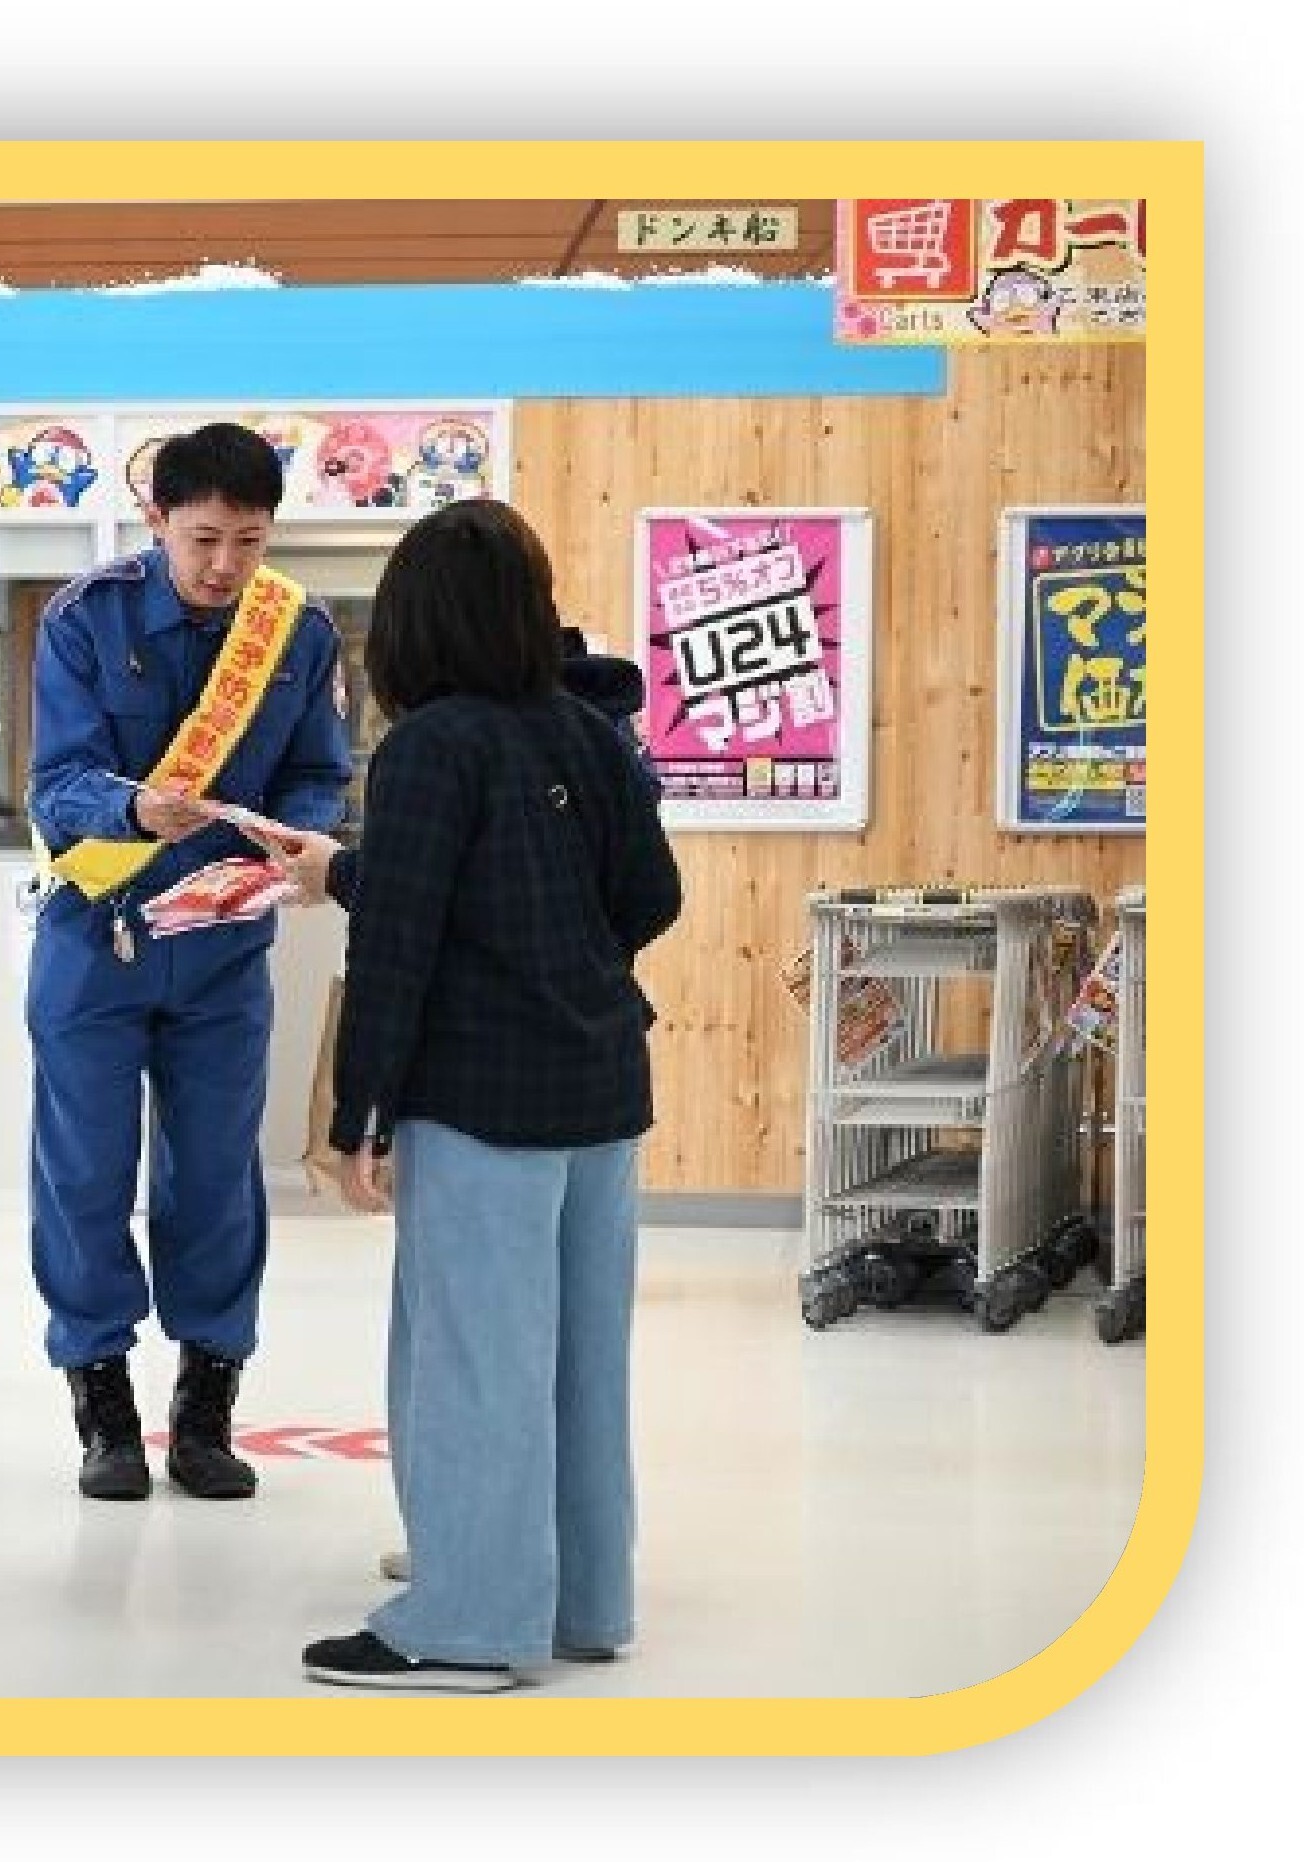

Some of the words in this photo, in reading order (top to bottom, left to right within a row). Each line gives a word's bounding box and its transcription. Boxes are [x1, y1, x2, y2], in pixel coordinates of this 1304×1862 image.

[635, 210, 781, 247] ドンキ船
[991, 200, 1147, 262] カー
[880, 306, 946, 333] Carts
[680, 606, 812, 686] U24
